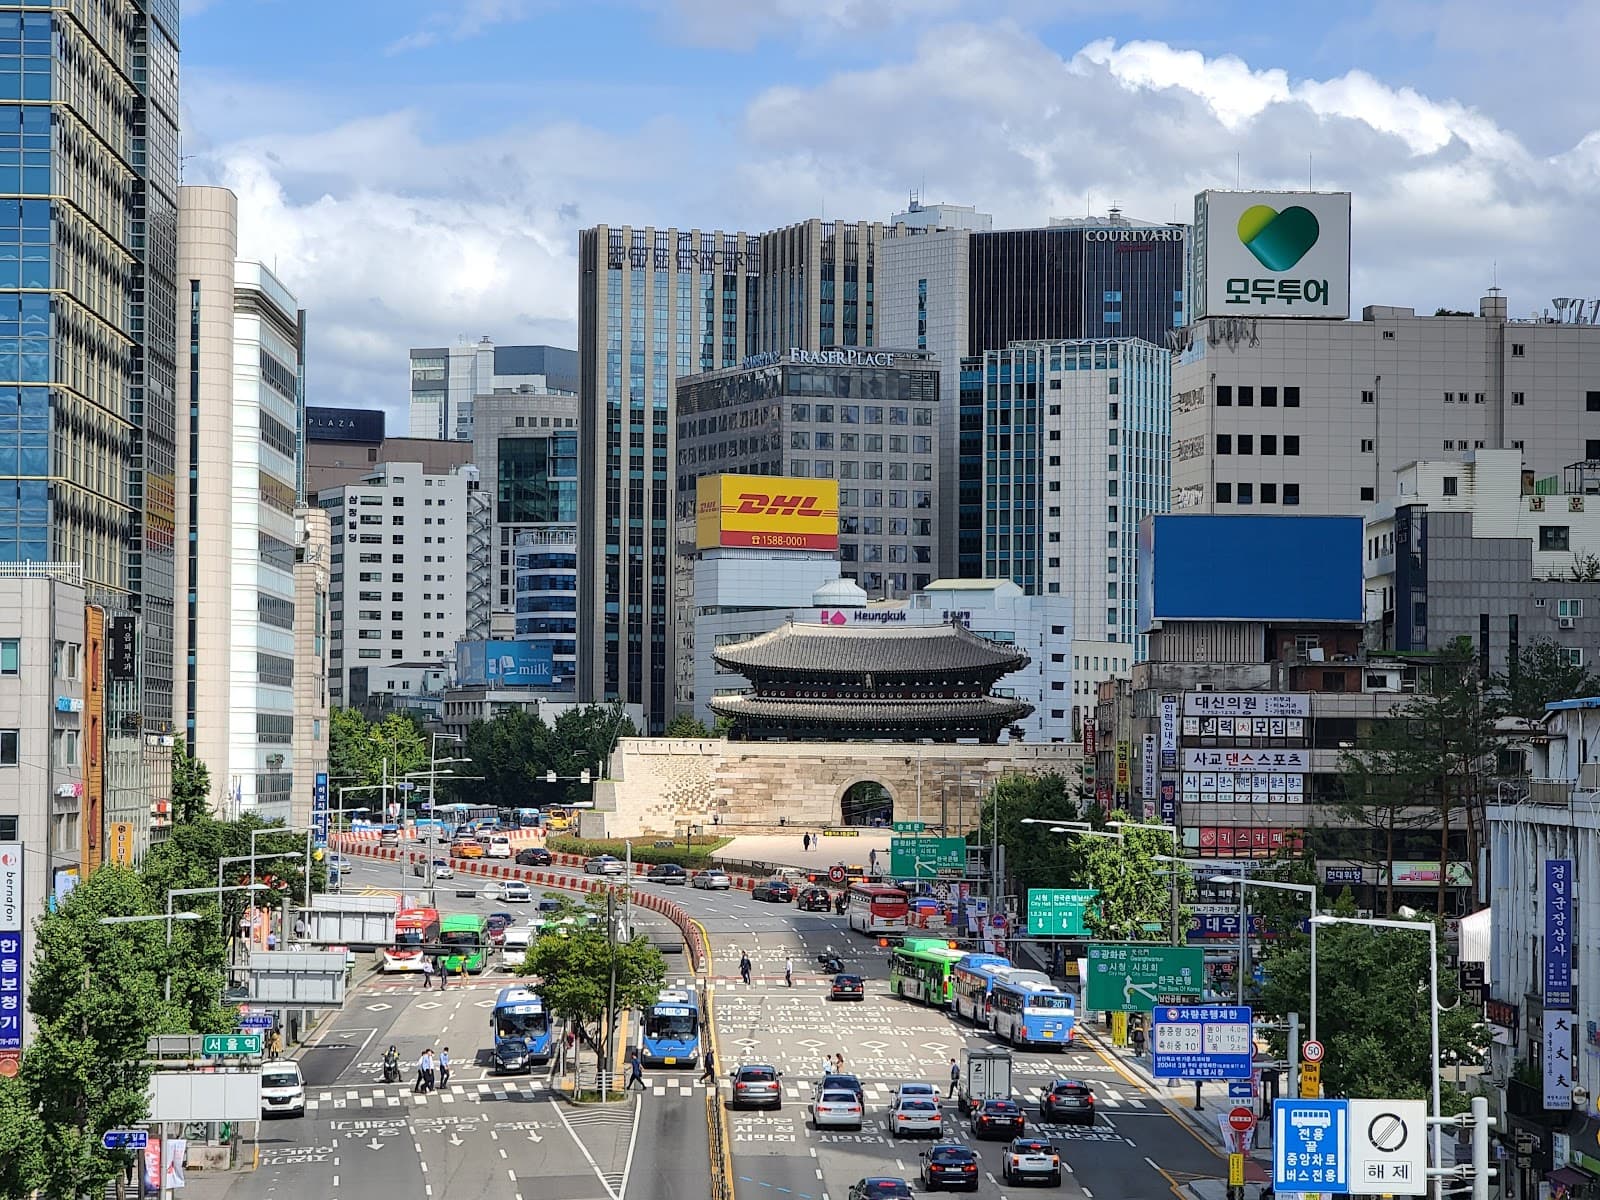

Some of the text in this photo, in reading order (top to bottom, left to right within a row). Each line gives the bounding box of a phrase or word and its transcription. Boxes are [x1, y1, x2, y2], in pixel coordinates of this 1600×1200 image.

[1085, 229, 1184, 242] COURTYARD
[1225, 278, 1329, 306] 모두투어
[308, 418, 355, 428] PLAZA
[736, 493, 823, 517] DHL
[762, 535, 807, 546] 1588-0001
[854, 610, 906, 624] Heungkuk
[1195, 696, 1257, 709] 대신의원
[1164, 704, 1173, 748] 인력안내소
[1255, 720, 1284, 735] 모집
[6, 870, 17, 922] bernafon
[1101, 949, 1127, 960] 광화문
[1109, 963, 1158, 972] 시청 시의회
[1159, 975, 1192, 985] 한국은행
[1053, 1000, 1066, 1008] 201
[1180, 1009, 1238, 1020] 차량운행제한
[209, 1037, 257, 1050] 서울역
[1307, 1046, 1320, 1056] 50
[1554, 1017, 1570, 1088] 大丈夫
[975, 1063, 982, 1072] Z
[733, 1134, 796, 1142] 시의회
[1298, 1127, 1325, 1141] 전용
[1305, 1141, 1319, 1153] 끝
[1286, 1153, 1337, 1167] 중앙차로
[1286, 1168, 1337, 1183] 버스전용
[1368, 1164, 1409, 1180] 해제
